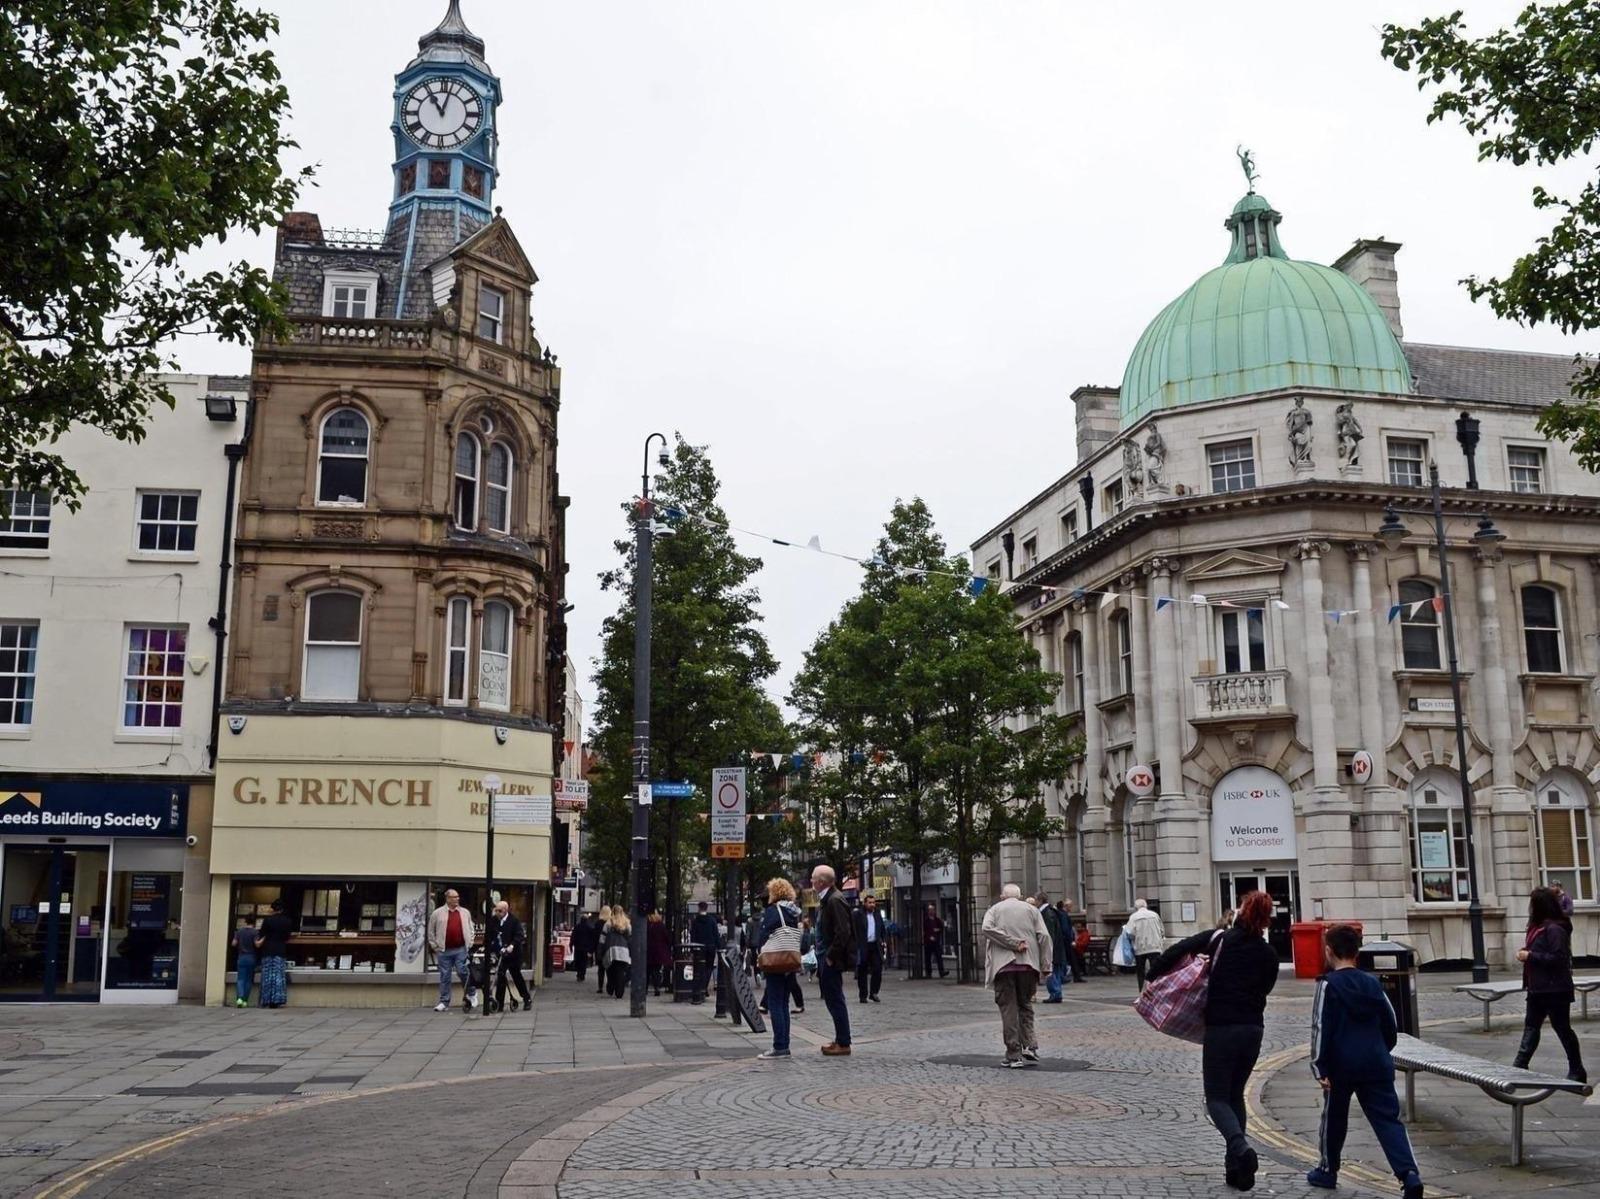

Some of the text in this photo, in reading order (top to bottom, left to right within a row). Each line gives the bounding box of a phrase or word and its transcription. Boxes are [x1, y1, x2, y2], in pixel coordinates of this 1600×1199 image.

[719, 774, 738, 782] ZONE
[233, 777, 433, 807] G. FRENCH
[458, 779, 534, 796] JEWLERY
[1223, 789, 1281, 800] HSBC UK
[42, 811, 101, 829] Building
[104, 812, 162, 830] Society
[1230, 825, 1279, 835] Welcome
[1225, 837, 1284, 847] to Doncaster
